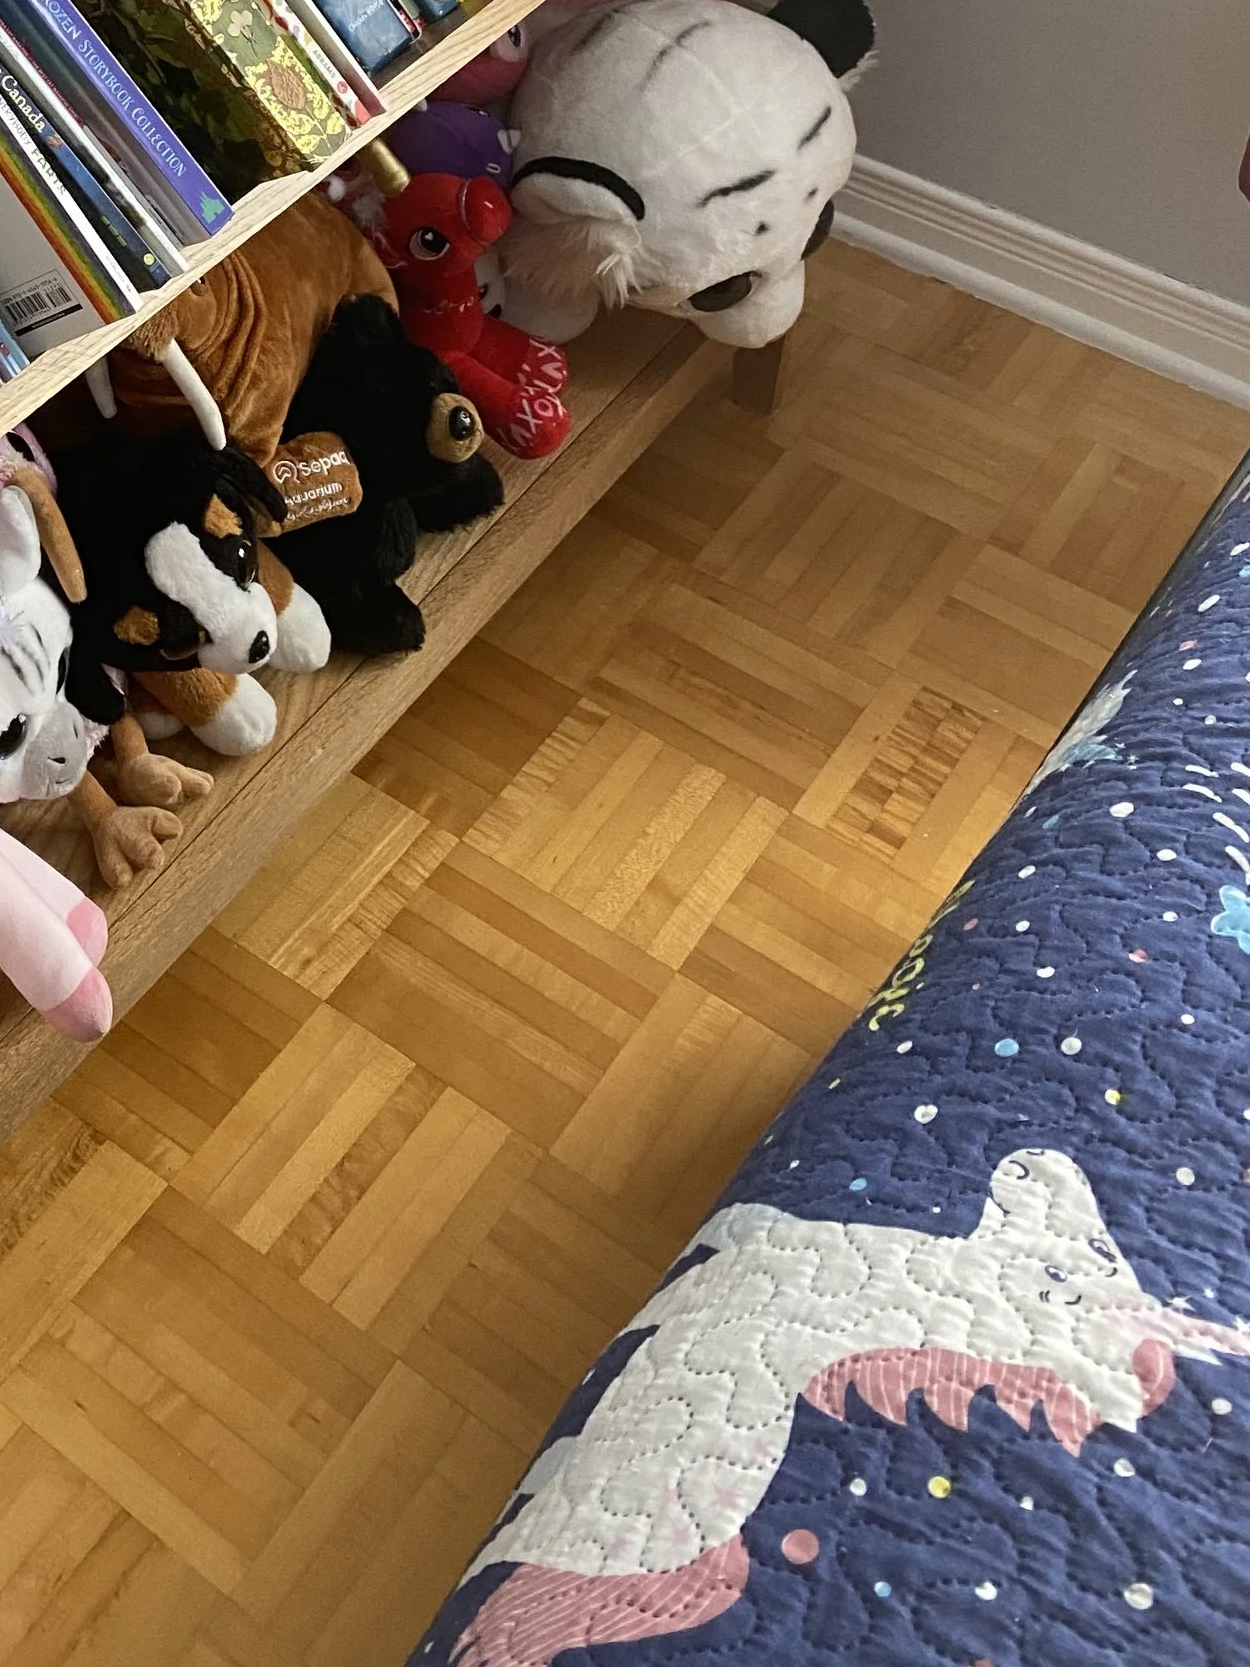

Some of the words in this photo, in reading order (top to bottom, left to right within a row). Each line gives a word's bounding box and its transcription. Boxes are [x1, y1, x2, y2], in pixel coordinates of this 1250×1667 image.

[310, 47, 338, 80] ABRAMS
[75, 38, 137, 110] STORYBOOK
[127, 104, 190, 178] COLLECTION
[29, 147, 68, 197] FARTS
